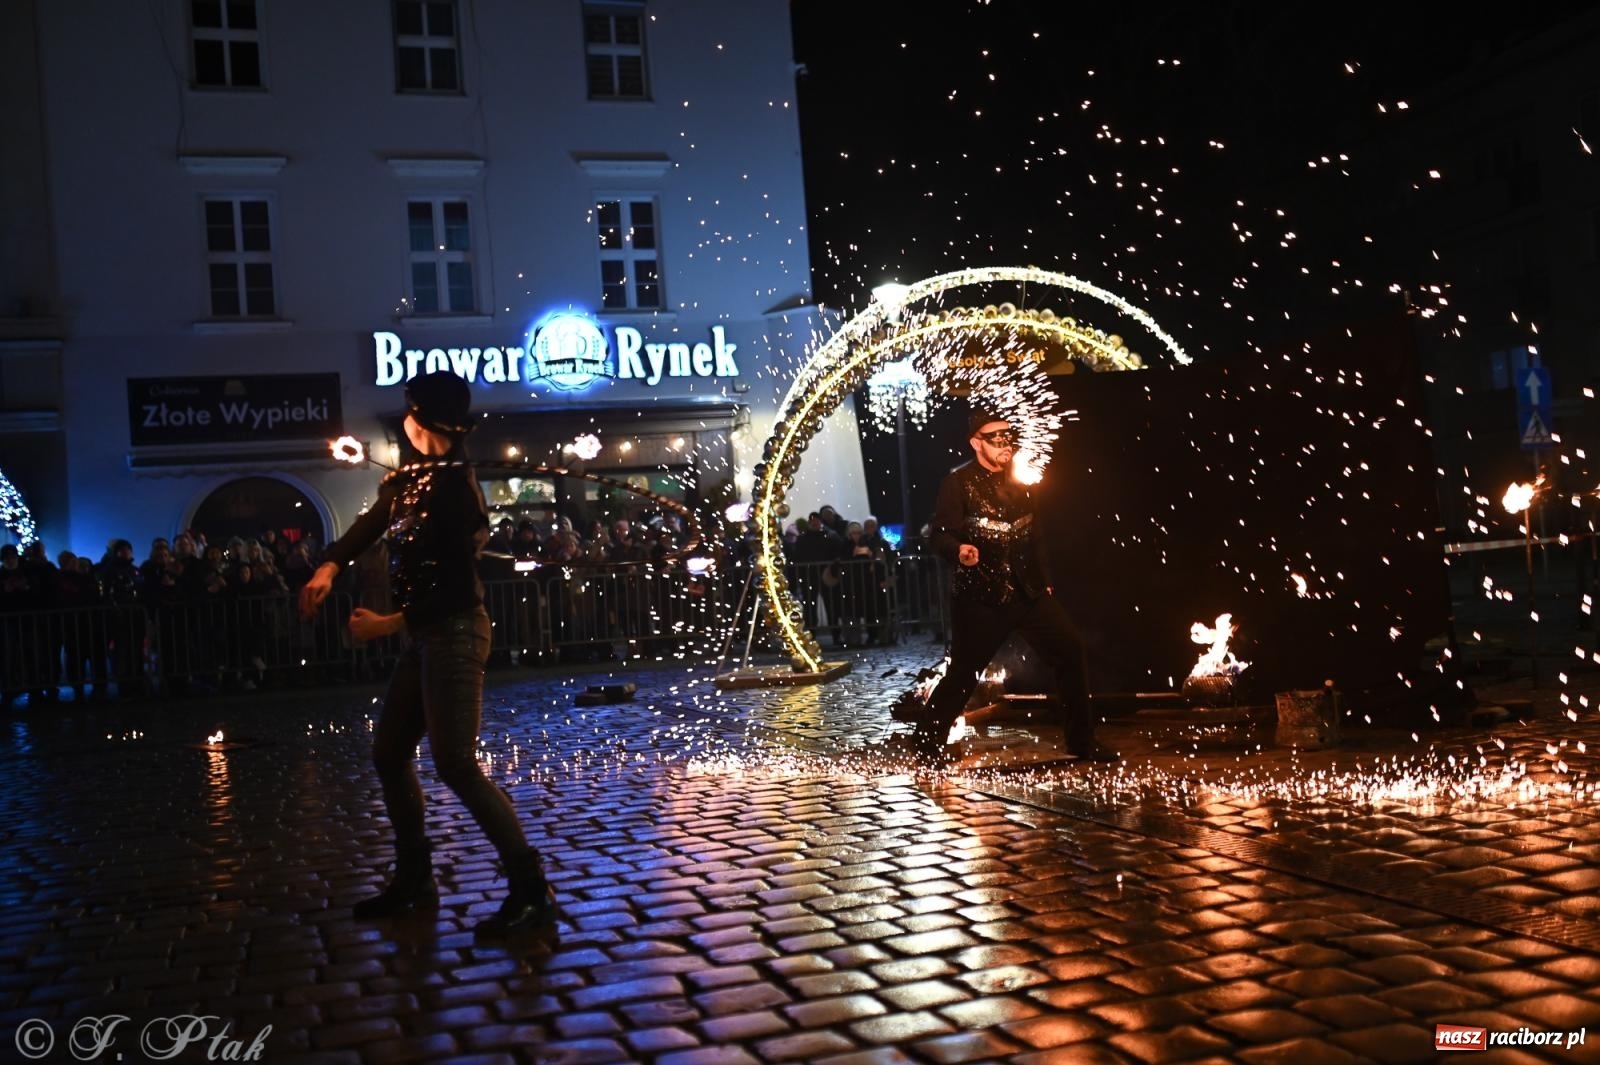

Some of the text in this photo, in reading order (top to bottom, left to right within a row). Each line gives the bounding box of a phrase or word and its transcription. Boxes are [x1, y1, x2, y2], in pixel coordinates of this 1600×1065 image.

[373, 325, 740, 386] Browar Rynek
[141, 397, 328, 429] Złote Wypieki
